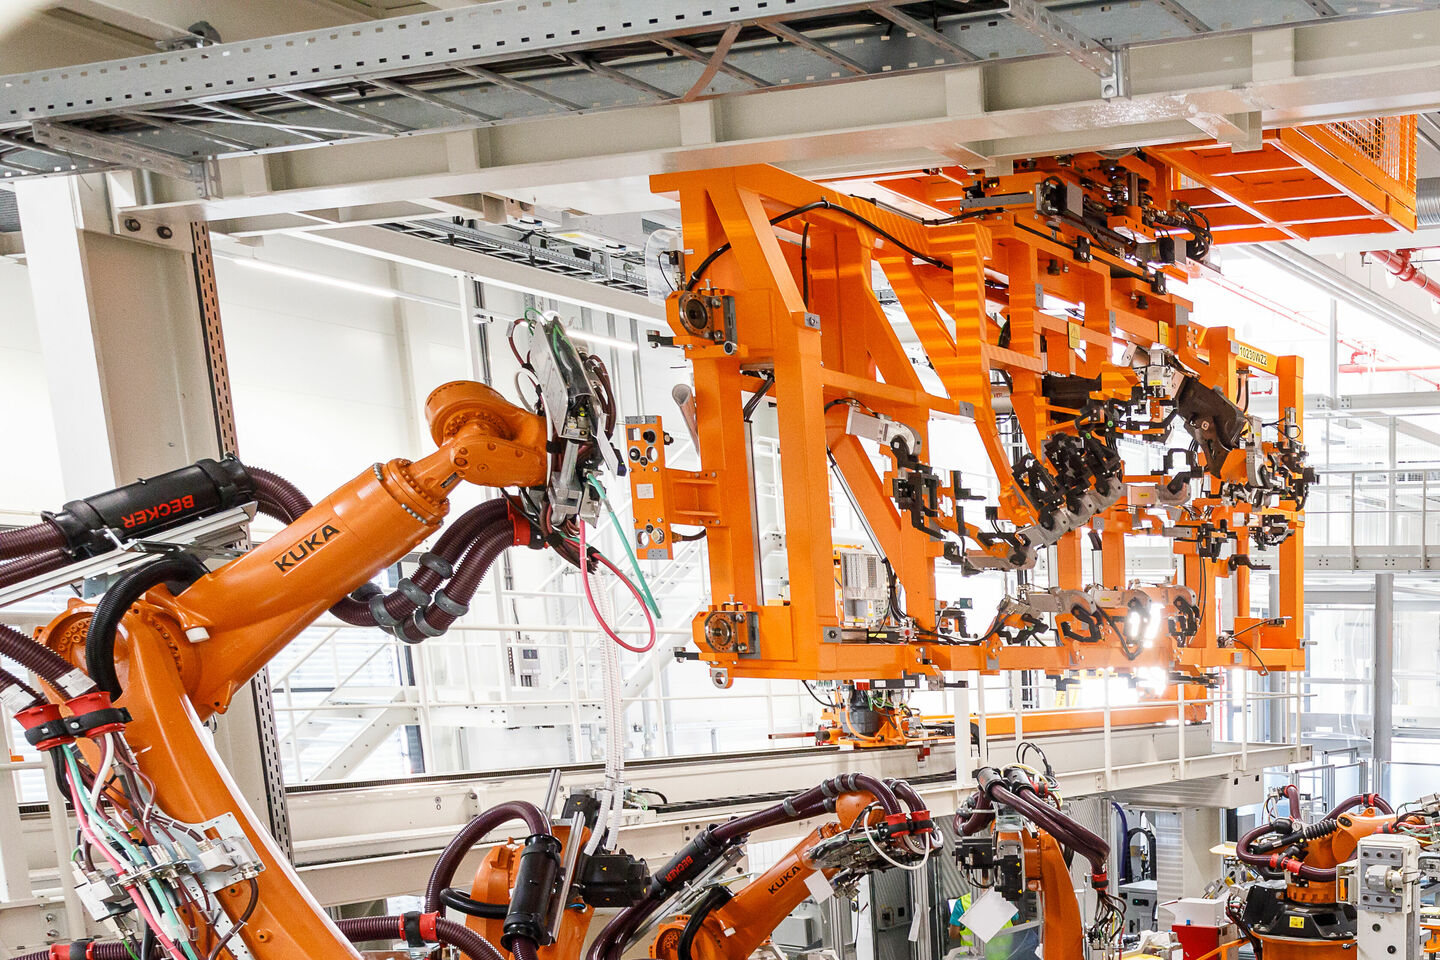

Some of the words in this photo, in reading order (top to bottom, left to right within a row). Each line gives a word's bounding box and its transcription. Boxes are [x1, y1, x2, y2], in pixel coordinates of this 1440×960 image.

[120, 494, 195, 529] BECKER
[274, 521, 340, 572] KUKA
[664, 855, 694, 882] BECKER
[767, 866, 801, 895] KUKA
